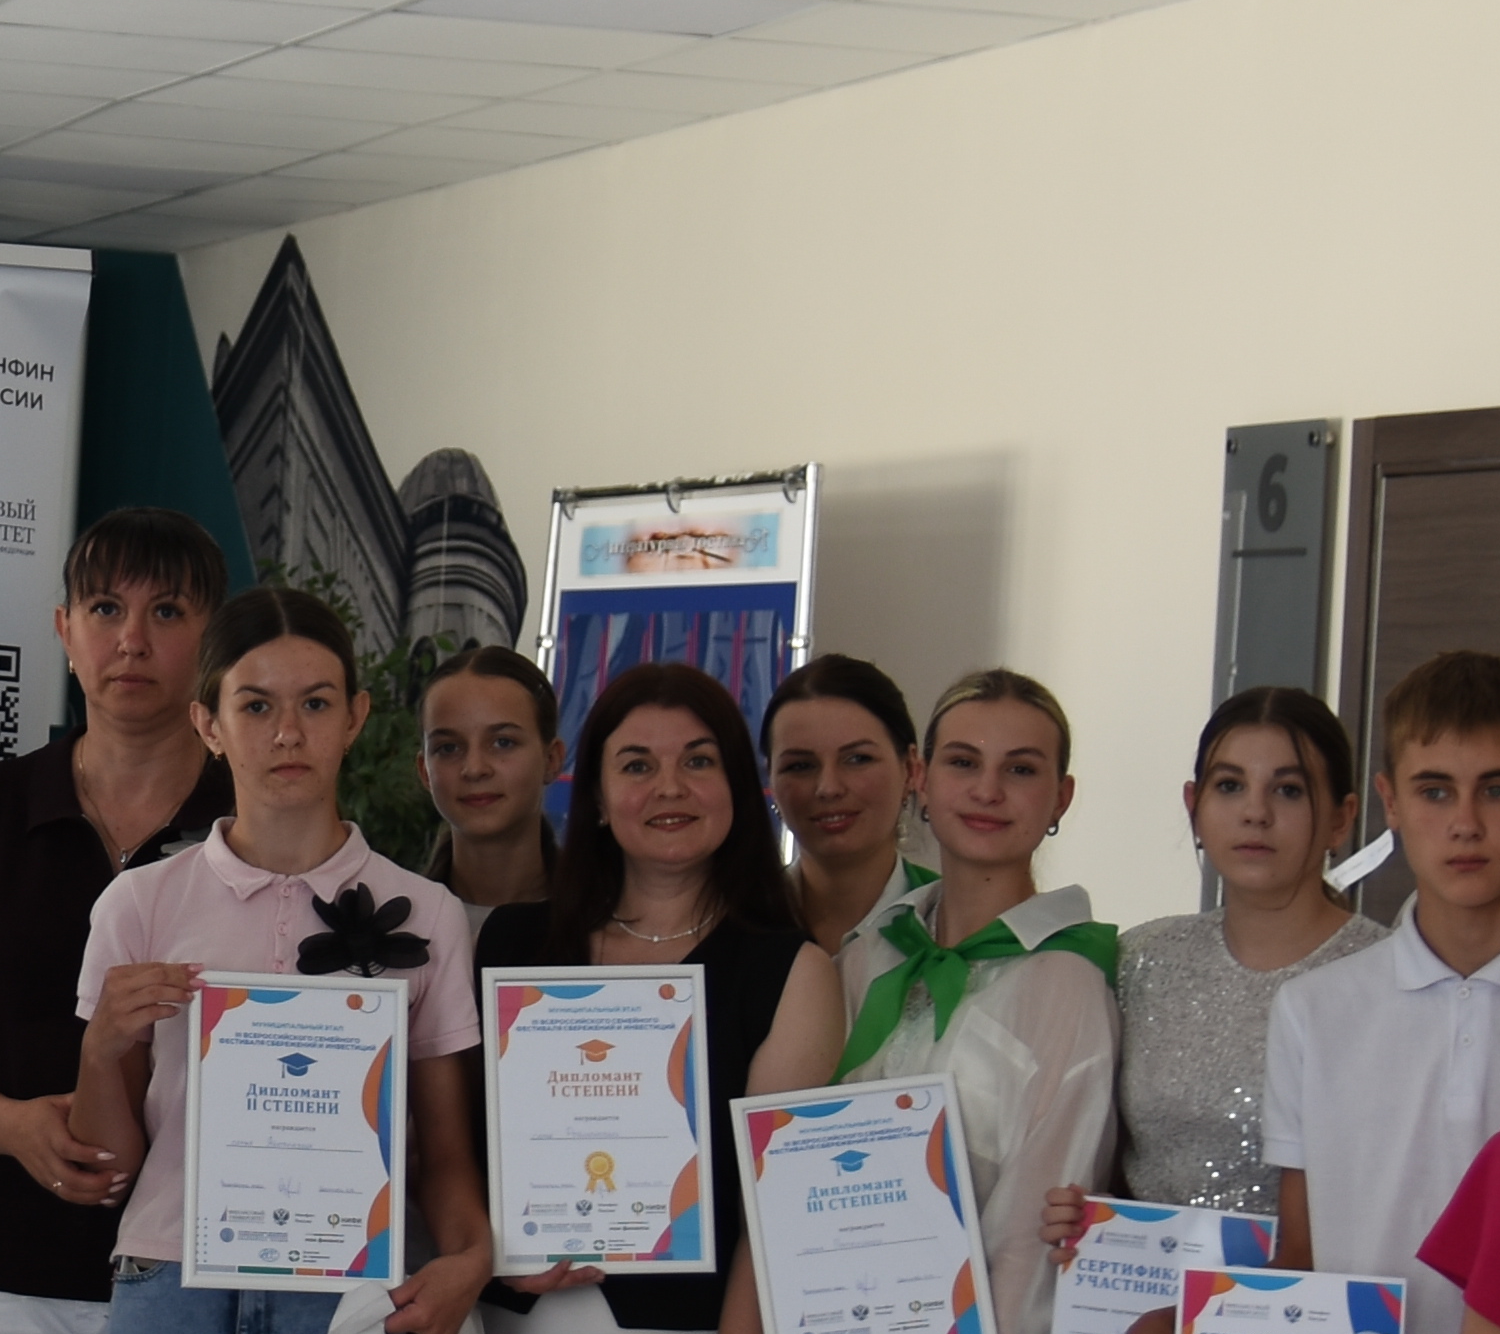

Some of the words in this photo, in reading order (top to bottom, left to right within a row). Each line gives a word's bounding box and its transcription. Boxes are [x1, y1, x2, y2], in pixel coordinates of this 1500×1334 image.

[1256, 454, 1289, 533] 6
[546, 1070, 643, 1084] Дипломант
[245, 1083, 342, 1100] Дипломант
[551, 1085, 557, 1097] I
[561, 1084, 639, 1097] СТЕПЕНИ
[246, 1098, 257, 1111] II
[262, 1099, 340, 1115] СТЕПЕНИ
[806, 1178, 904, 1200] Дипломант
[806, 1200, 824, 1213] III
[829, 1189, 908, 1211] СТЕПЕНИ
